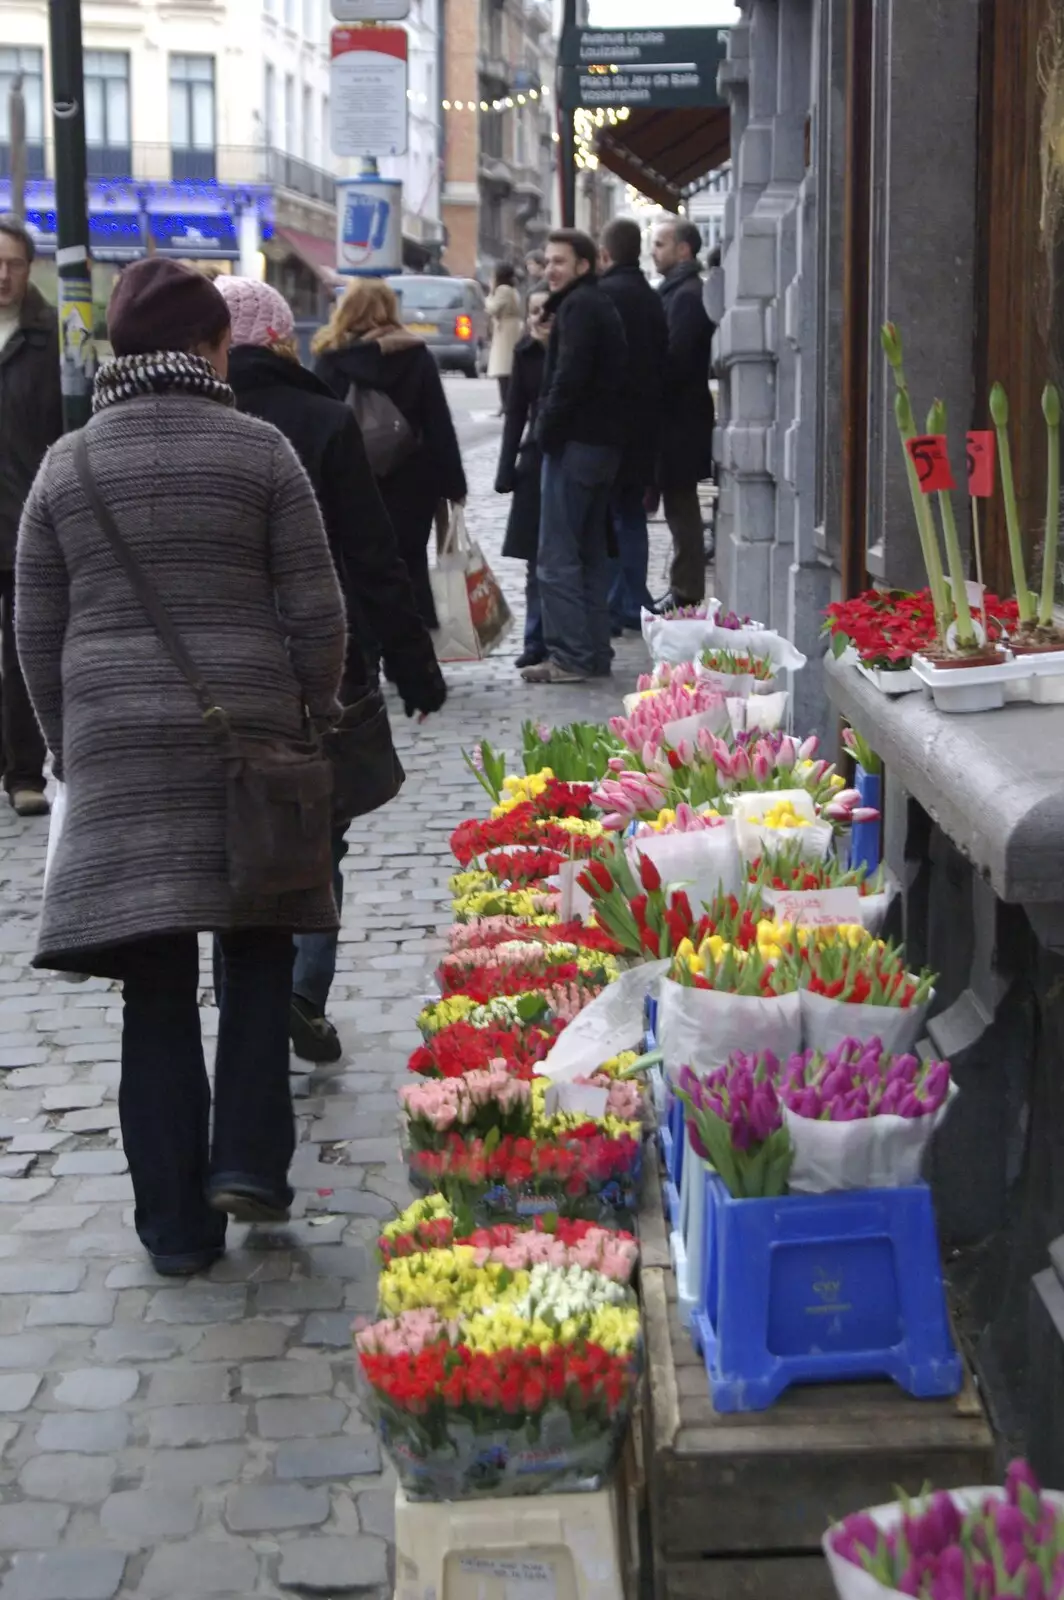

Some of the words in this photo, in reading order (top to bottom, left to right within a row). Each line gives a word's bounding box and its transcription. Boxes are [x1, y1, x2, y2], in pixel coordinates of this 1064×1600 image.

[581, 32, 625, 44] Avenue
[627, 31, 664, 43] Louise
[580, 75, 610, 87] Place
[612, 75, 628, 87] du
[631, 74, 650, 87] Jeu
[653, 74, 668, 86] de
